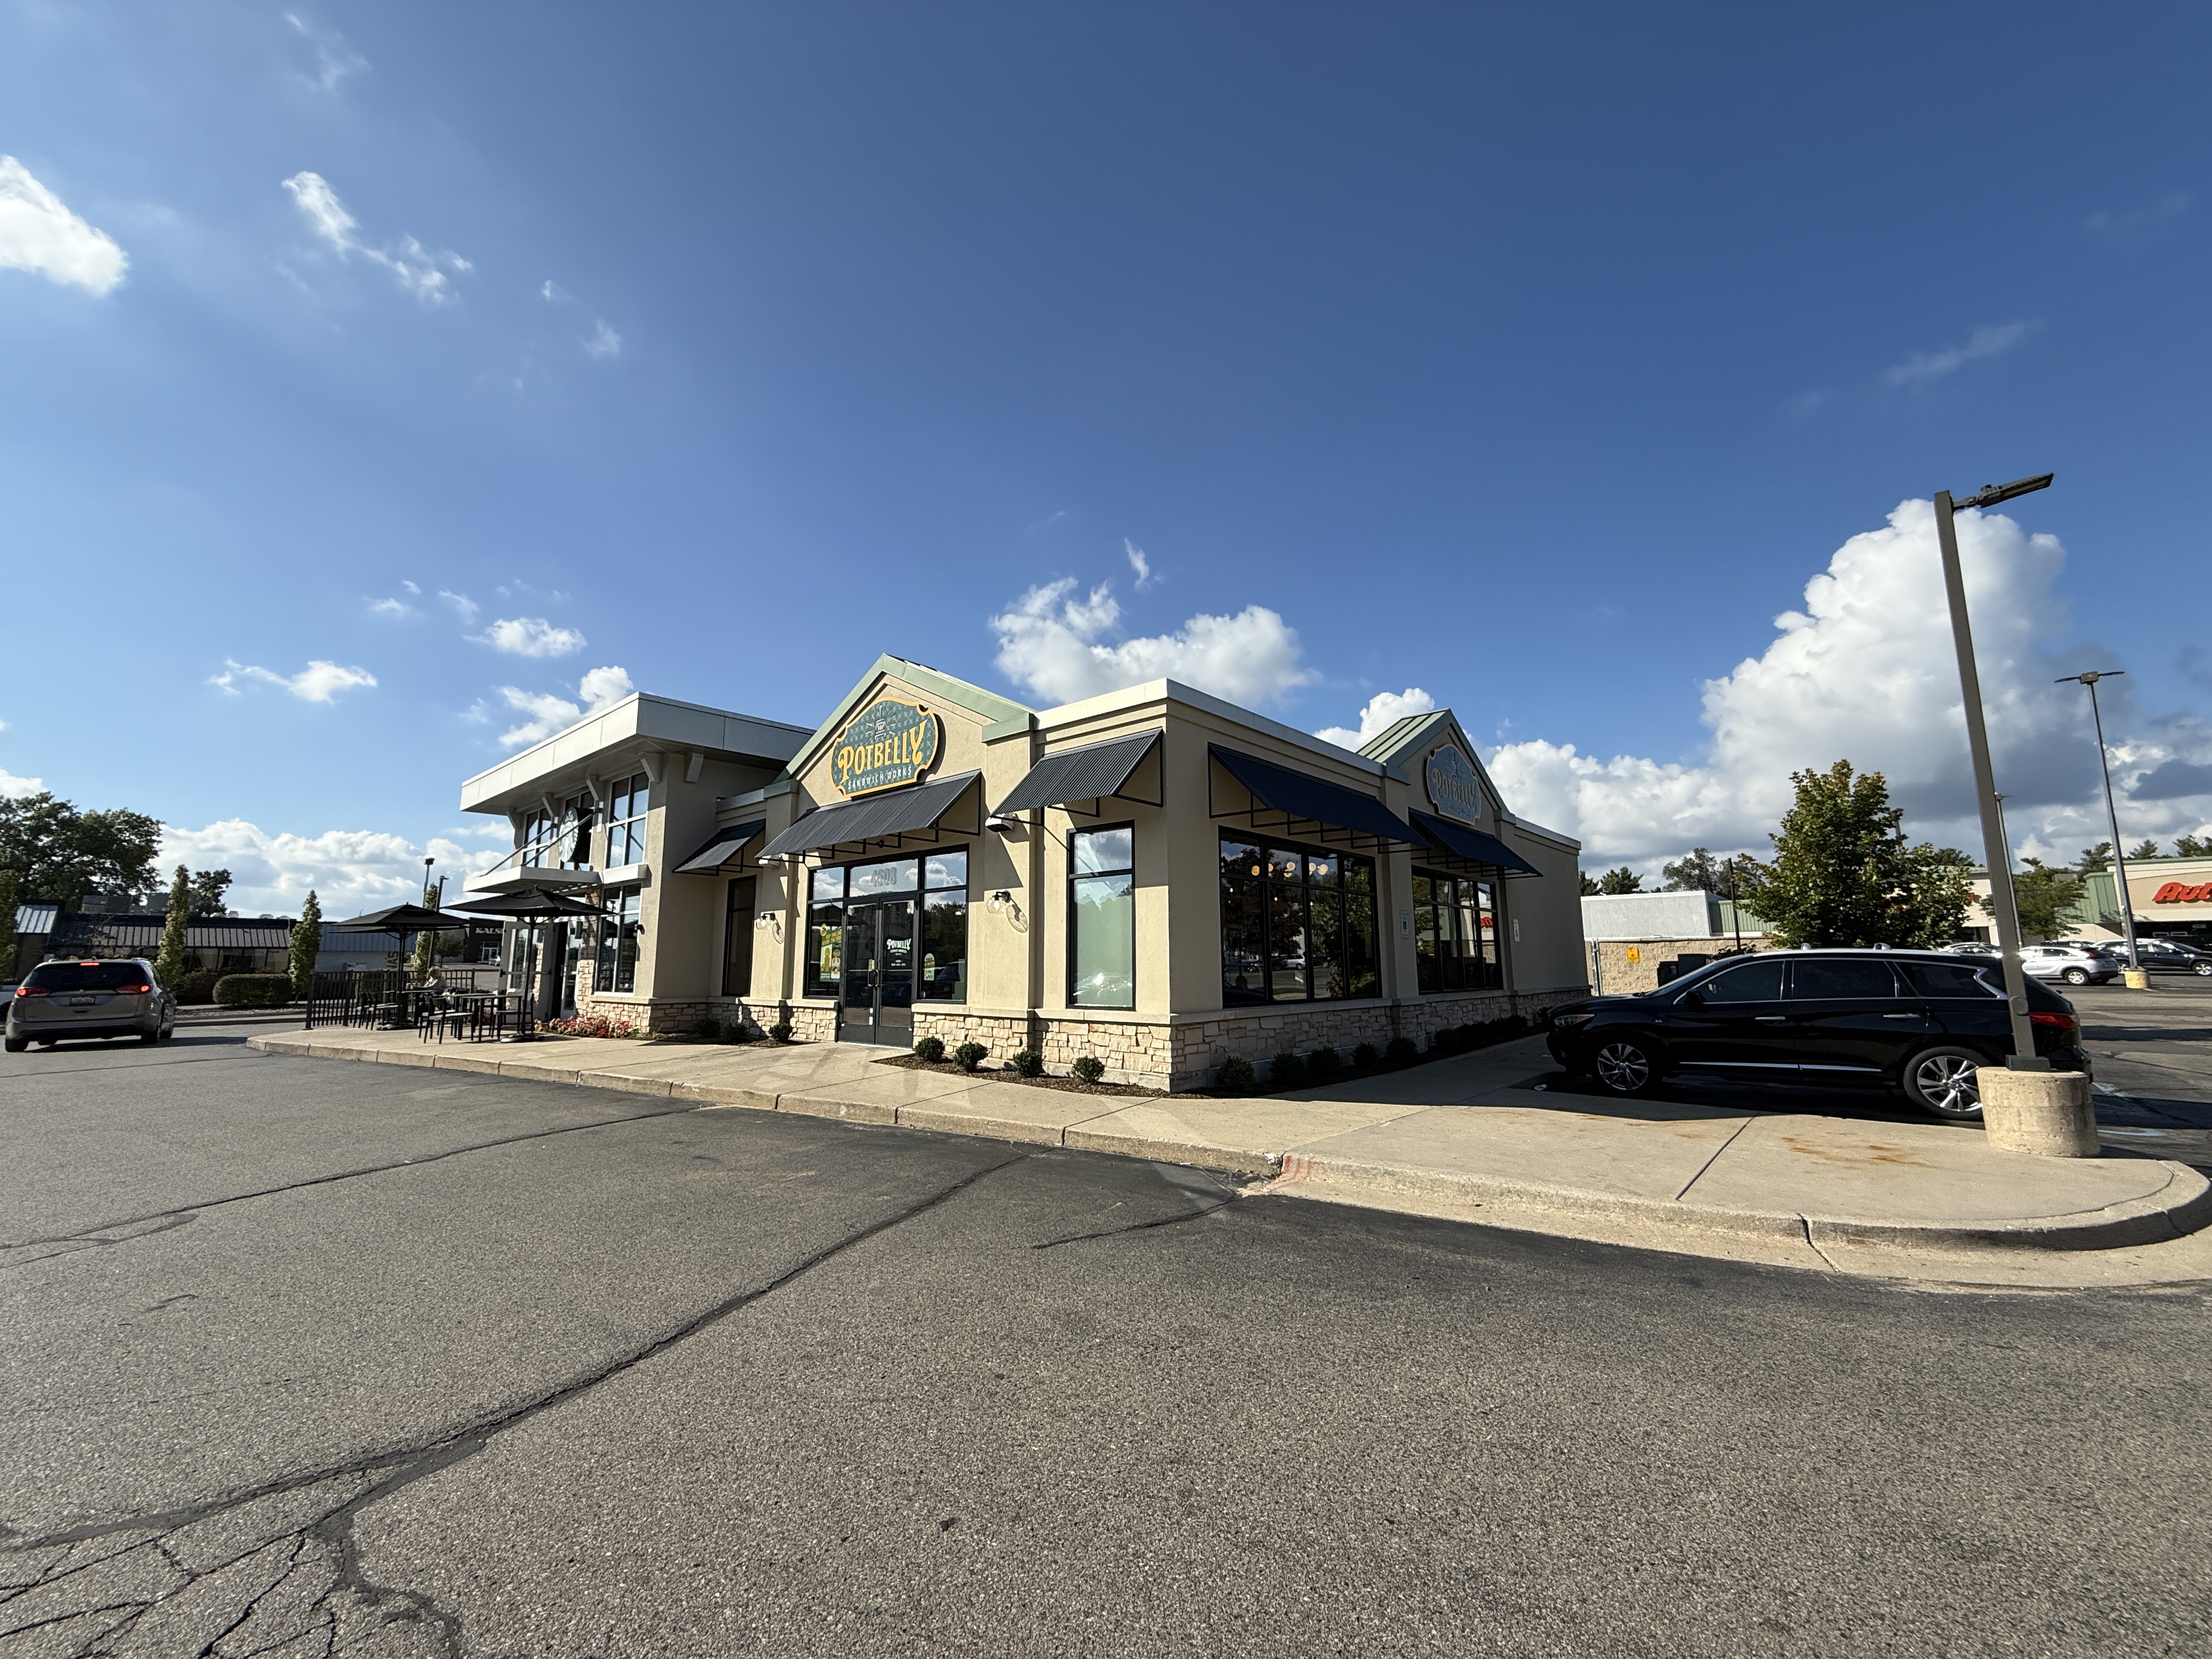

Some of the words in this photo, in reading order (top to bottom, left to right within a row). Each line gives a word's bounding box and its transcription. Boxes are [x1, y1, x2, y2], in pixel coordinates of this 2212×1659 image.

[838, 719, 928, 784] POTBELLY
[848, 773, 884, 789] SANDWICH
[887, 766, 912, 780] WORKS
[1432, 768, 1477, 813] POTBELLY
[871, 867, 898, 887] 4608
[887, 938, 912, 950] POTBELLY
